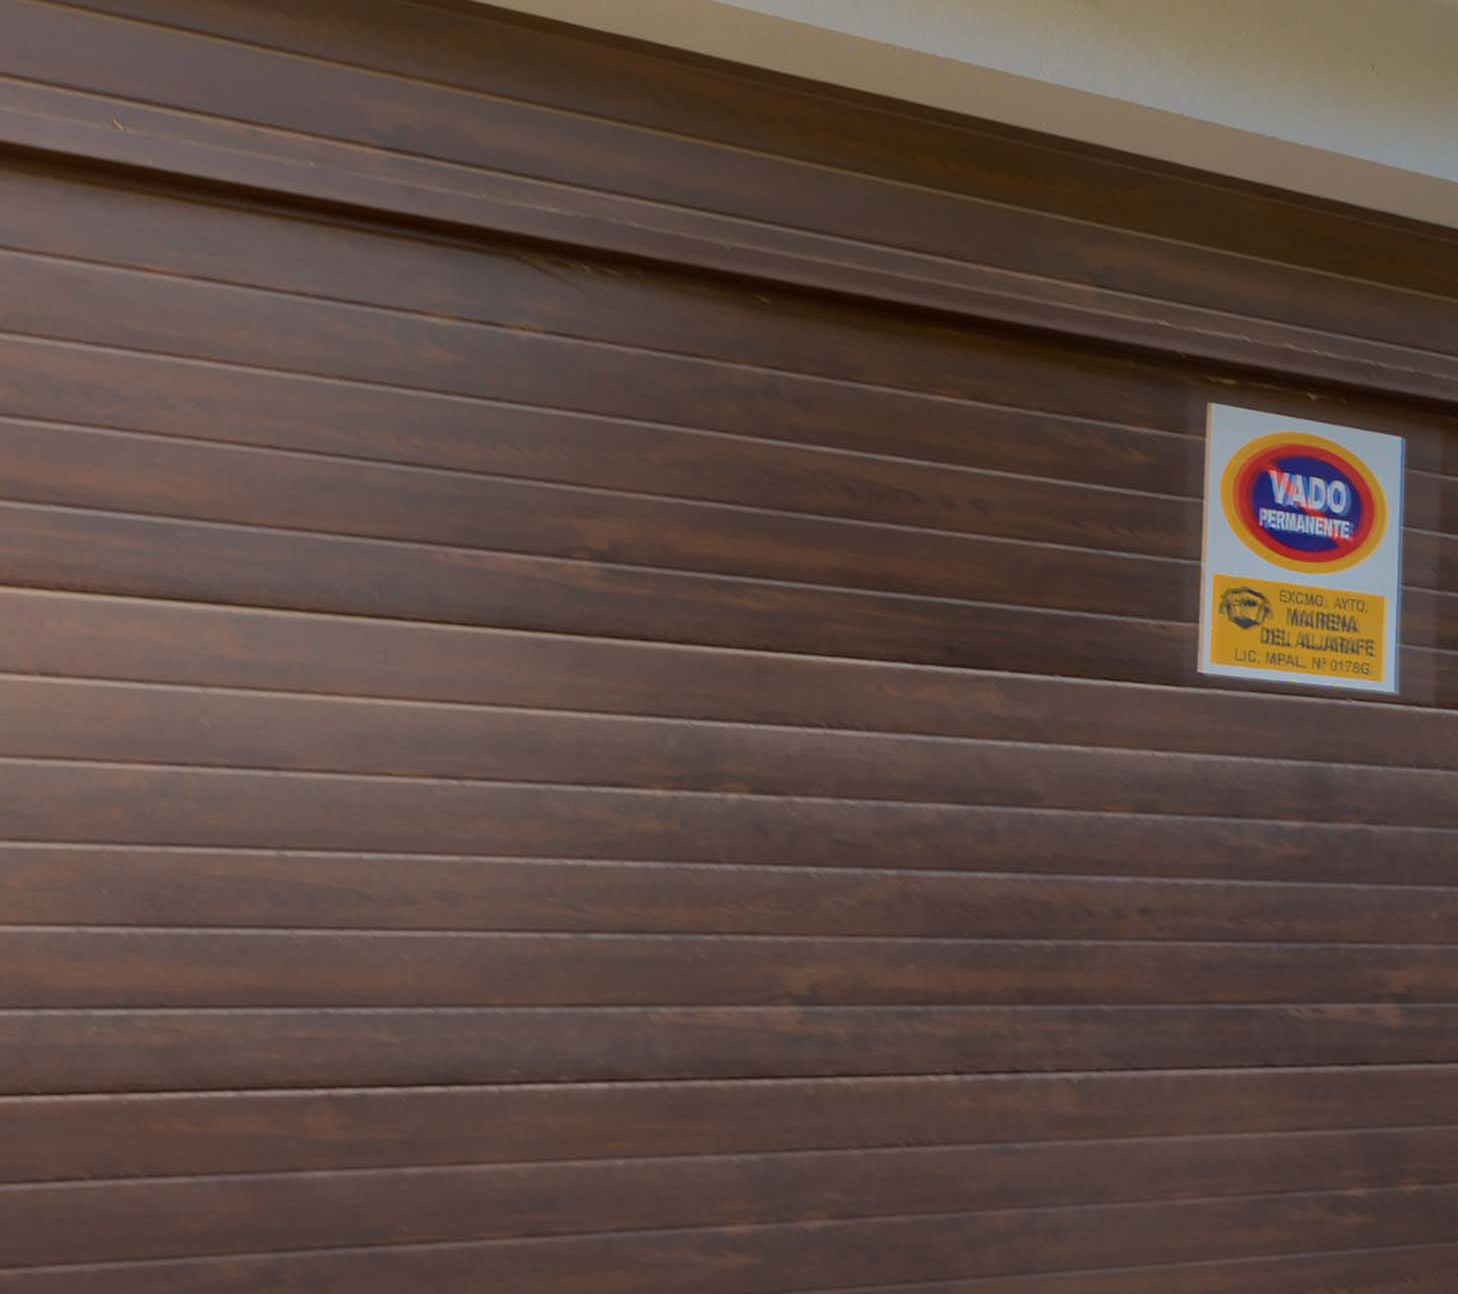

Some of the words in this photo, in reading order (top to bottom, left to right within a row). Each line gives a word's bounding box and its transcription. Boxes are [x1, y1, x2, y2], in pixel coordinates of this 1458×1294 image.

[1269, 470, 1350, 516] VADO
[1258, 507, 1353, 541] PERMANENTE
[1286, 609, 1360, 633] MAIRENA
[1260, 627, 1291, 647] DEL
[1295, 632, 1376, 657] ALJARAFE
